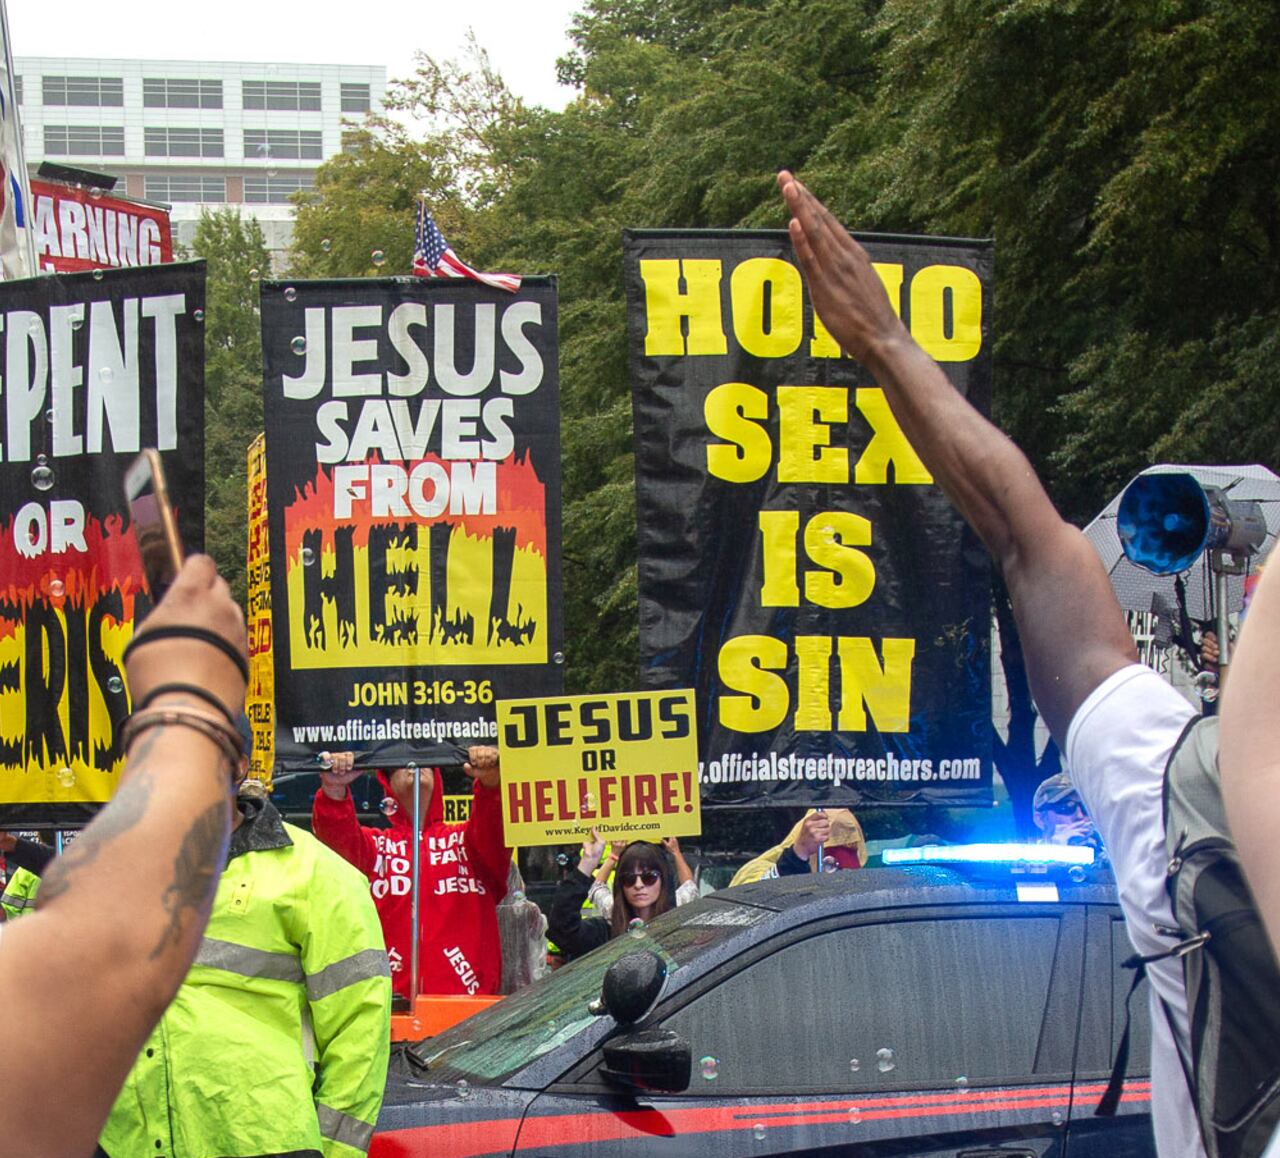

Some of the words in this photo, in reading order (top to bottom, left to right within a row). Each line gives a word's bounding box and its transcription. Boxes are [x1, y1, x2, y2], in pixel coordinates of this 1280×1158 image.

[31, 193, 162, 267] ARNING
[282, 302, 543, 400] JESUS
[316, 397, 515, 464] SAVES
[704, 383, 935, 485] SEX
[334, 460, 497, 520] FROM
[13, 499, 87, 559] OR
[758, 510, 876, 609] IS
[300, 522, 537, 650] HELL
[348, 682, 407, 708] JOHN
[412, 680, 494, 706] 3:16-36
[718, 635, 916, 734] SIN
[504, 695, 691, 748] JESUS
[582, 749, 616, 772] OR
[508, 771, 694, 824] HELLFIRE!
[443, 946, 480, 996] JESUS
